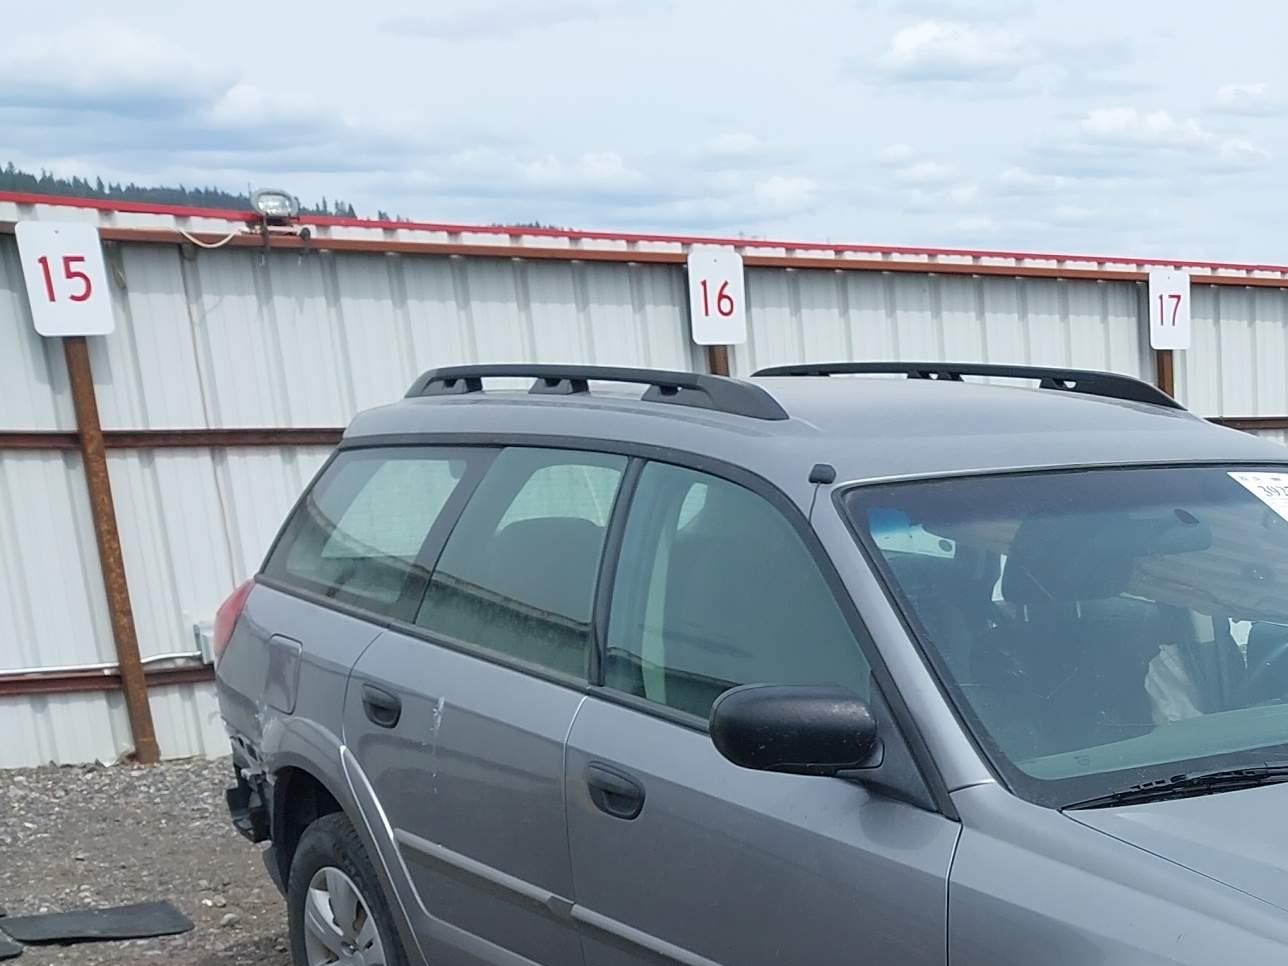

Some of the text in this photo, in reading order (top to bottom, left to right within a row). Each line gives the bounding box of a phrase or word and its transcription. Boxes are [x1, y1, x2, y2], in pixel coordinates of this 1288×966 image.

[37, 255, 92, 302] 15
[700, 279, 735, 317] 16
[1158, 293, 1182, 327] 17
